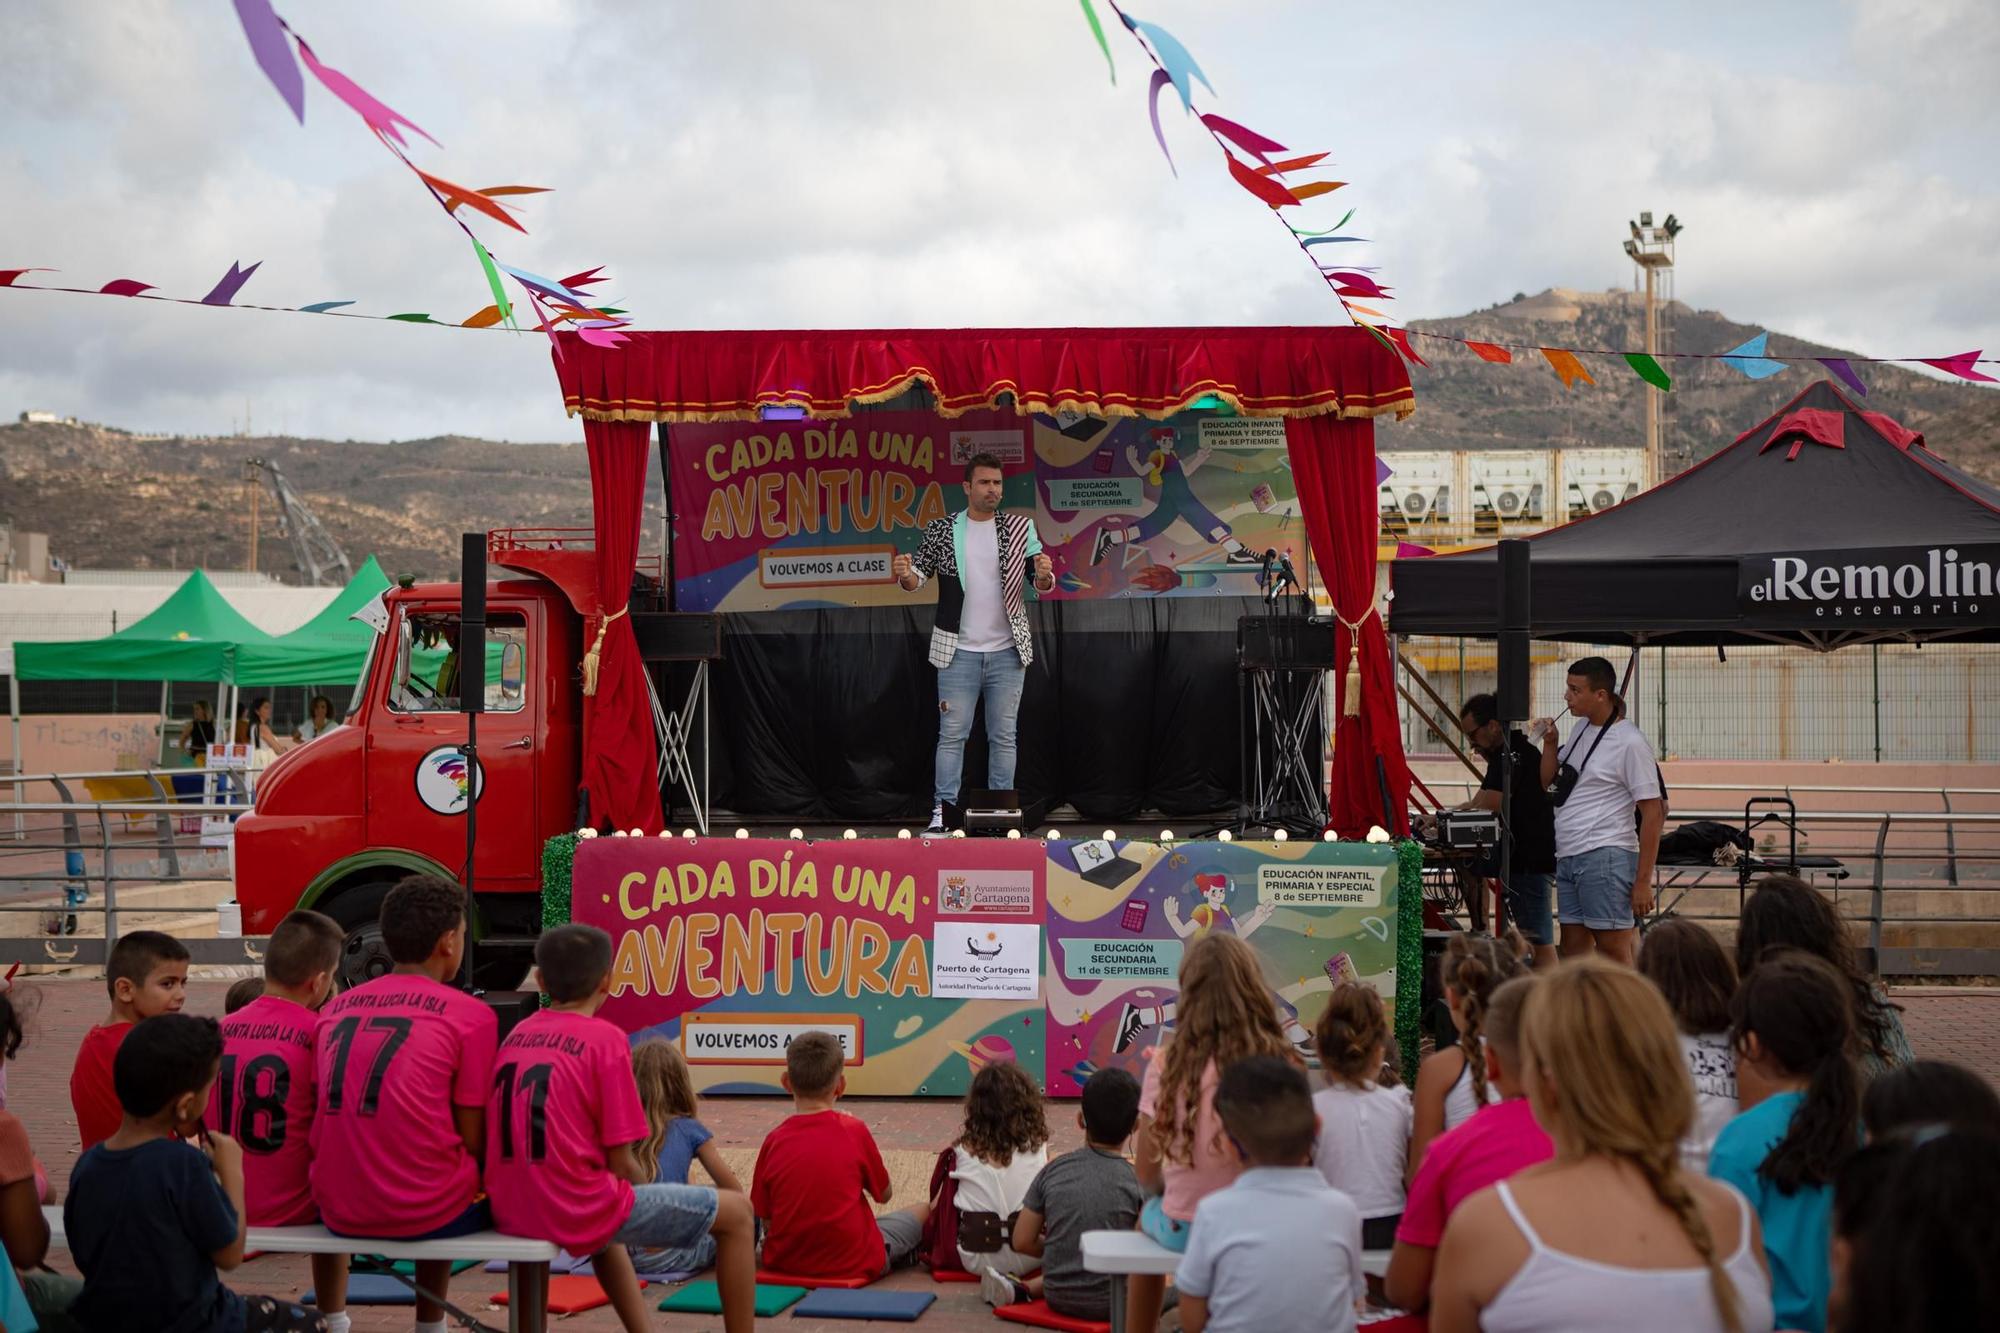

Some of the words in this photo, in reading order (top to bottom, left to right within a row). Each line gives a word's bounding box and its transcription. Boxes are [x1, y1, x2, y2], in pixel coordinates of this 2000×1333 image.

[1202, 420, 1249, 429] EDUCACIÓN
[705, 432, 795, 481] CADA
[803, 422, 859, 459] DÍA
[868, 430, 934, 474] UNA
[1072, 480, 1120, 489] EDUCACIÓN
[1070, 490, 1122, 498] SECUNDARIA
[701, 467, 947, 541] AVENTURA
[769, 561, 833, 576] VOLVEMOS
[837, 560, 845, 574] A
[848, 560, 886, 573] CLASE
[1263, 869, 1323, 879] EDUCACIÓN
[1325, 870, 1375, 881] INFANTIL,
[619, 861, 736, 920] CADA
[749, 850, 818, 899] DÍA
[832, 864, 916, 923] UNA
[974, 885, 1030, 894] Ayuntamiento
[1265, 881, 1315, 890] PRIMARIA
[1317, 882, 1324, 891] Y
[1326, 882, 1375, 892] ESPECIAL
[974, 893, 1030, 905] Cartagena
[1274, 892, 1281, 901] 8
[1283, 893, 1295, 901] de
[1298, 893, 1363, 903] SEPTIEMBRE
[608, 908, 931, 998] AVENTURA
[1094, 942, 1154, 952] EDUCACIÓN
[1090, 954, 1157, 964] SECUNDARIA
[937, 964, 967, 972] Puerto
[970, 965, 981, 973] de
[983, 965, 1030, 975] Cartagena
[1077, 966, 1086, 974] 11
[1089, 966, 1101, 974] de
[1103, 966, 1169, 975] SEPTIEMBRE
[967, 983, 993, 991] Portuaria
[1001, 984, 1031, 992] Cartagena
[347, 994, 377, 1008] SANTA
[408, 993, 423, 1007] LA
[423, 995, 448, 1016] ISLA
[279, 1025, 294, 1042] LA
[560, 1035, 586, 1056] ISLA
[695, 1033, 778, 1049] VOLVEMOS
[325, 1016, 414, 1118] 17
[218, 1052, 292, 1154] 18
[495, 1061, 554, 1167] 11
